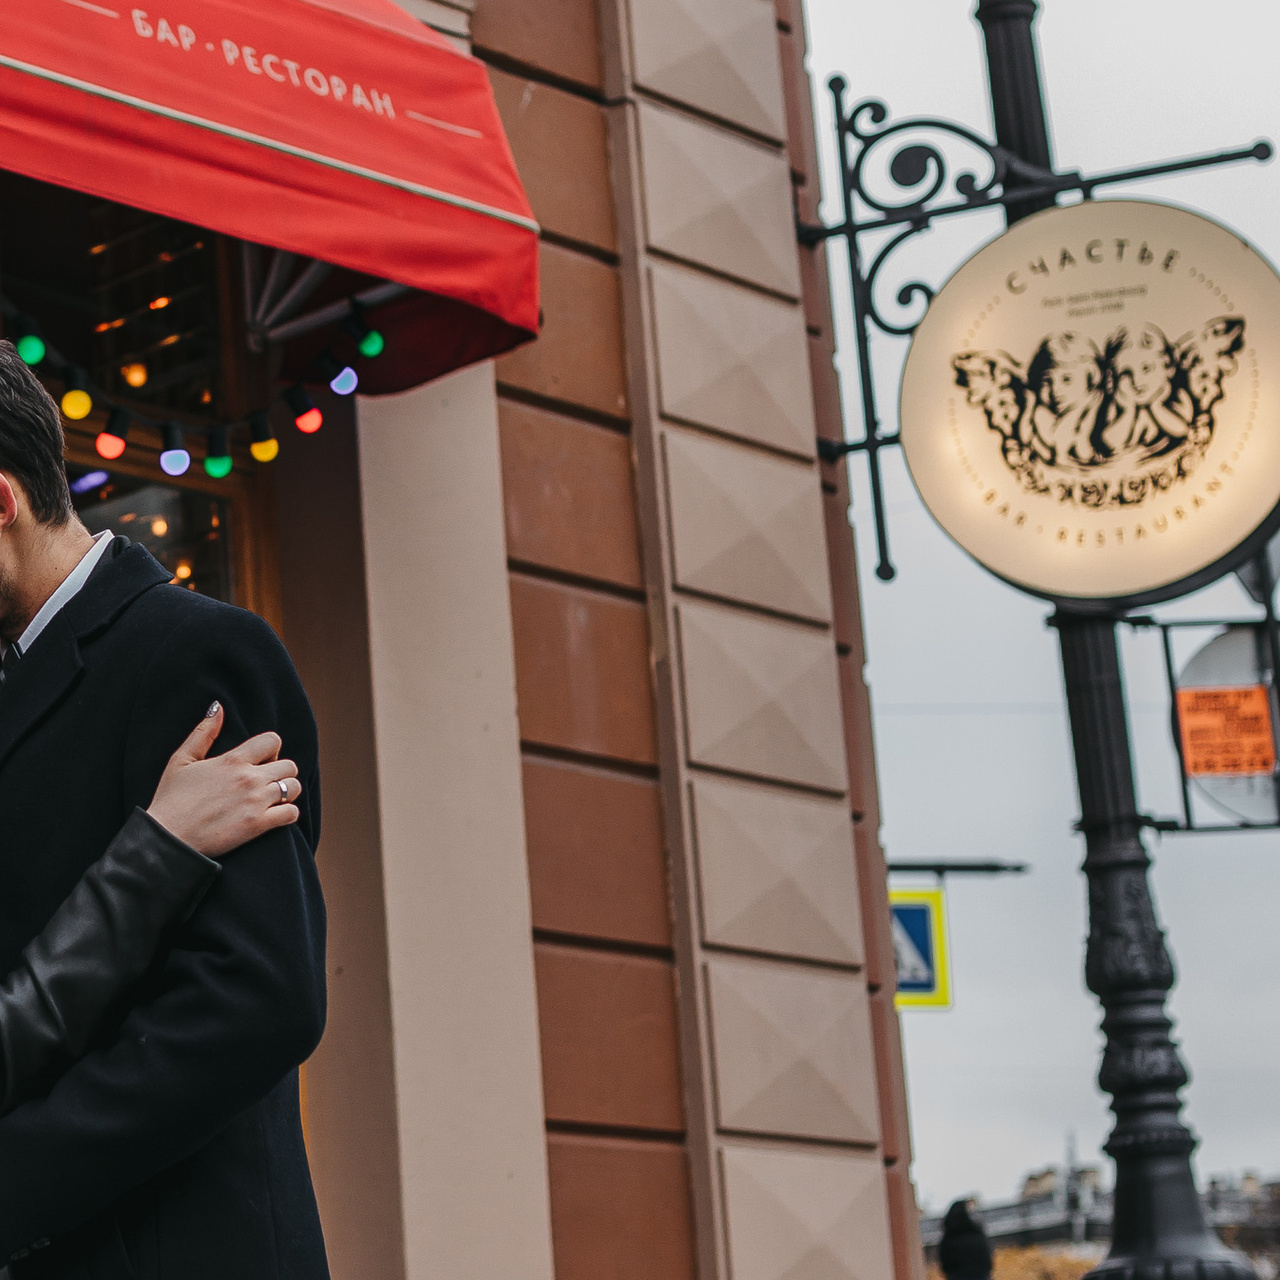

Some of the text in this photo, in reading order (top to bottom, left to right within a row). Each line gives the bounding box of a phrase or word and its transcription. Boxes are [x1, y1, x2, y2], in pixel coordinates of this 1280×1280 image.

[130, 8, 396, 120] БАР РЕСТОРАН
[1006, 237, 1181, 295] СЧАСТЬЕ
